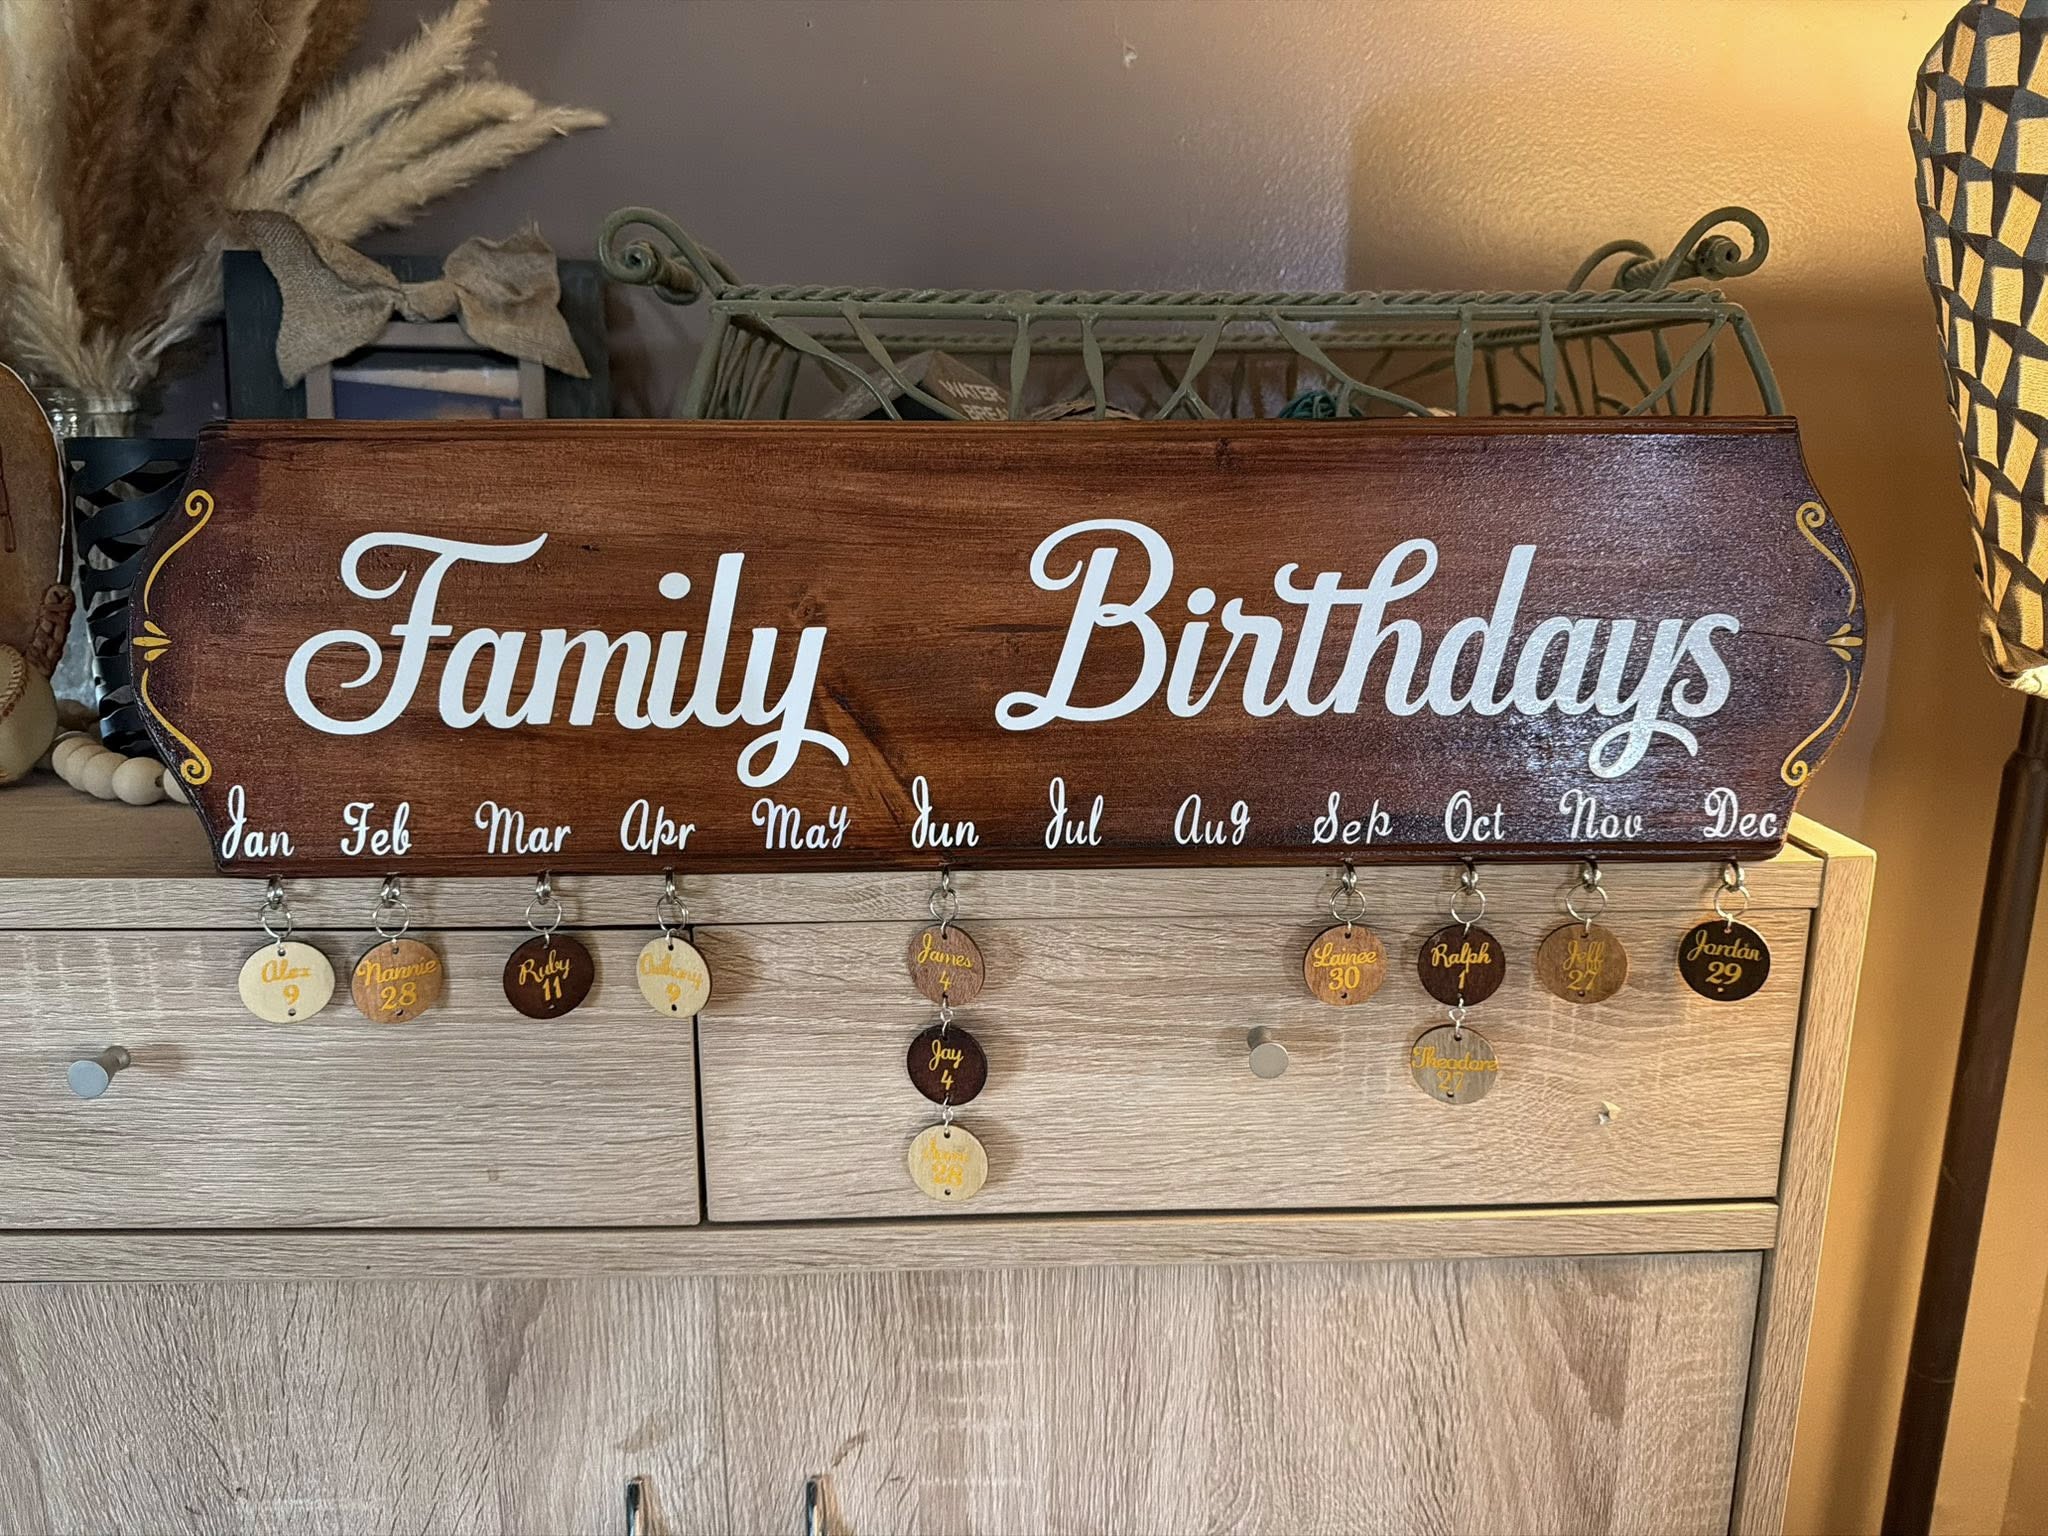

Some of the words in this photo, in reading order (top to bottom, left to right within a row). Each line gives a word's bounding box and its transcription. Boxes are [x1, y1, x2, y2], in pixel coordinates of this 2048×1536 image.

[285, 532, 849, 787] Family
[995, 519, 1739, 779] Birthdays
[222, 785, 294, 858] Jan
[341, 802, 412, 855] Feb
[475, 801, 571, 853] Mar
[621, 799, 695, 855] Apr
[752, 798, 851, 849] May
[912, 776, 979, 848] Jun
[1046, 777, 1103, 849] Jul
[1175, 794, 1250, 845] Aug
[1312, 792, 1392, 844] Sep
[1445, 790, 1505, 842] Oct
[1559, 787, 1642, 838] Nov
[1700, 787, 1777, 837] Dec
[919, 934, 972, 967] James
[1313, 942, 1378, 968] Lainee
[1431, 942, 1491, 971] Ralph
[1564, 940, 1605, 971] Jeff
[1685, 930, 1762, 961] Jordan
[261, 959, 312, 984] Alex
[355, 959, 438, 986] Nannie
[518, 949, 571, 985] Ruby
[1329, 966, 1361, 991] 30
[1706, 961, 1743, 985] 29
[542, 976, 563, 1001] 11
[939, 972, 951, 991] 4
[1457, 971, 1465, 989] 1
[1567, 970, 1596, 990] 27
[283, 985, 299, 1006] 9
[380, 982, 417, 1011] 28
[666, 984, 682, 1003] 9
[928, 1039, 963, 1071] Jay
[940, 1069, 953, 1089] 4
[1436, 1070, 1465, 1093] 27
